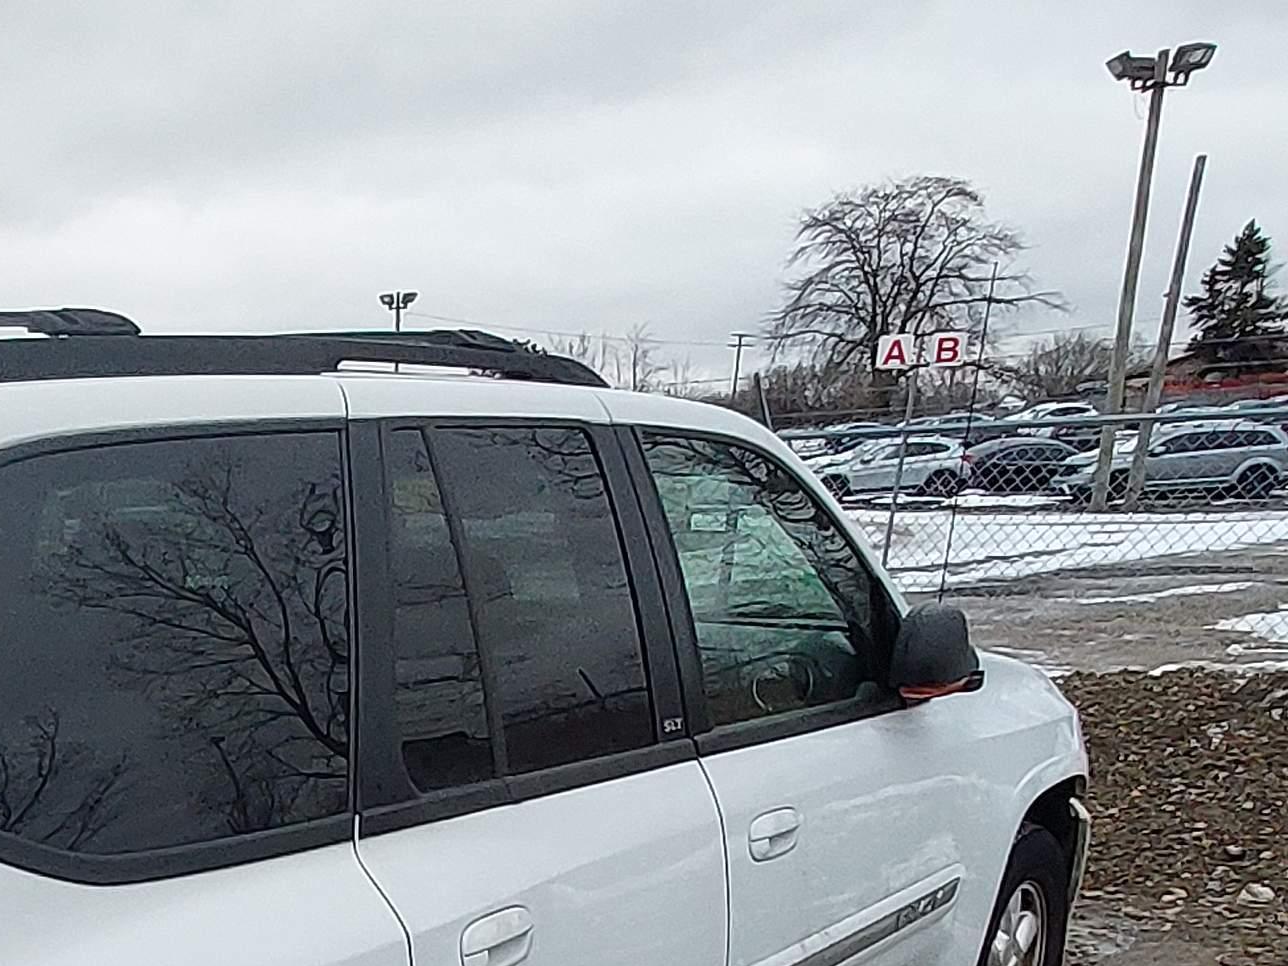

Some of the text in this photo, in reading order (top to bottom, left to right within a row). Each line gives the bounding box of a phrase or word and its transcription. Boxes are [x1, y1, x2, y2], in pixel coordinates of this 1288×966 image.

[882, 339, 907, 366] A
[935, 337, 960, 363] B
[663, 717, 684, 733] SLT
